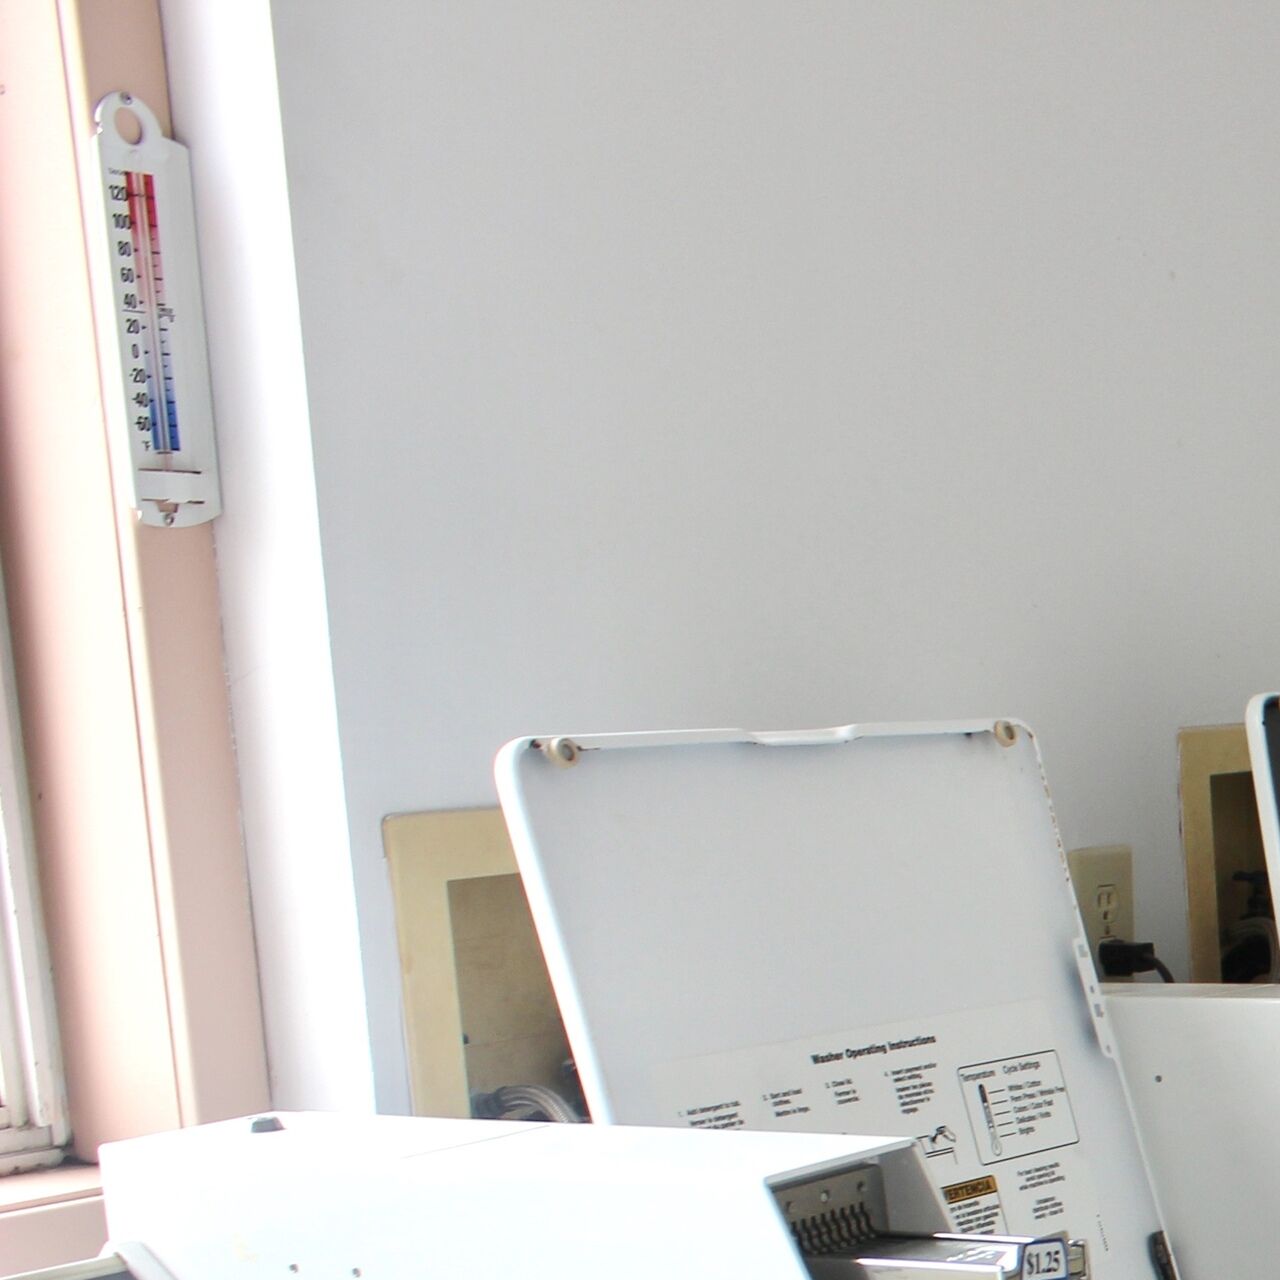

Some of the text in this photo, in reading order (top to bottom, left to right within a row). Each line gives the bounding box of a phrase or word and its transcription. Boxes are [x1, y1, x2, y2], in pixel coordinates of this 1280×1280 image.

[109, 185, 128, 201] 120
[112, 213, 132, 229] 100
[118, 241, 131, 257] 80
[120, 267, 134, 283] 60
[124, 293, 137, 309] 40
[126, 318, 140, 334] 20
[132, 344, 139, 359] 0
[811, 1052, 844, 1064] Washer
[845, 1045, 887, 1059] Operating
[1026, 1250, 1061, 1276] $1.25
